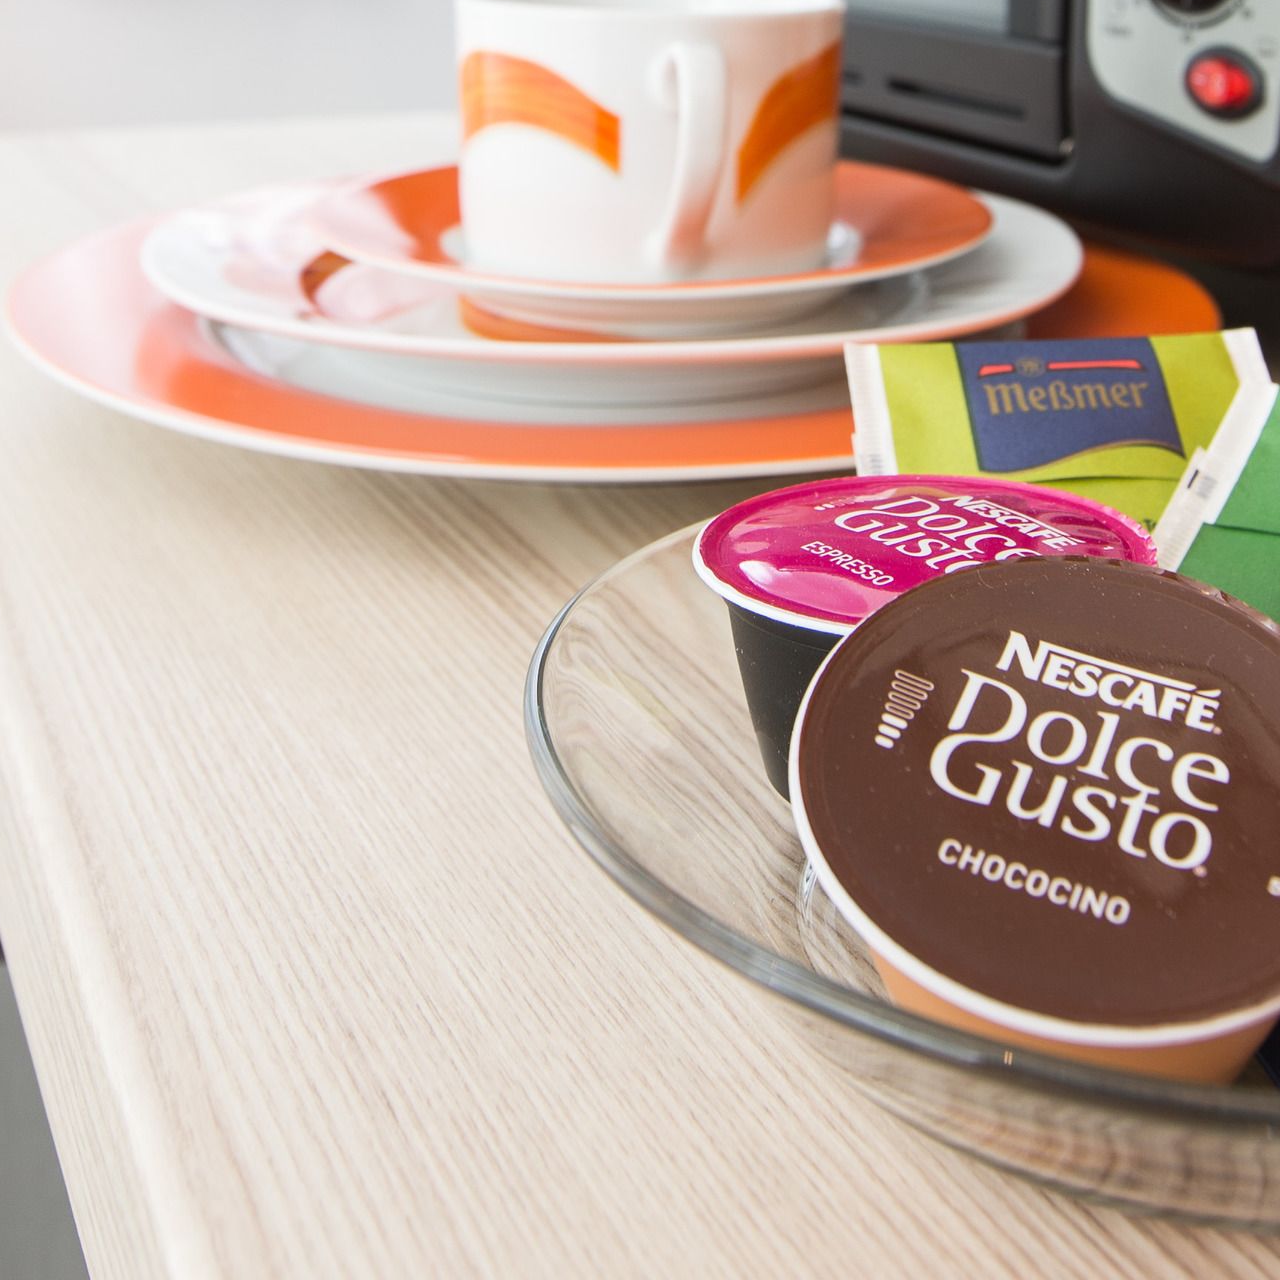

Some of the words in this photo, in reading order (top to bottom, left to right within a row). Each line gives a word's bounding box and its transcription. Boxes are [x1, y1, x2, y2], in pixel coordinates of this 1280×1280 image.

[800, 541, 894, 586] ESPRESSO
[939, 495, 1086, 549] NESCAFÉ
[995, 630, 1222, 733] NESCAFÉ
[947, 668, 1231, 812] Dolce
[929, 732, 1213, 871] Gusto
[937, 837, 1131, 925] CHOCOCINO
